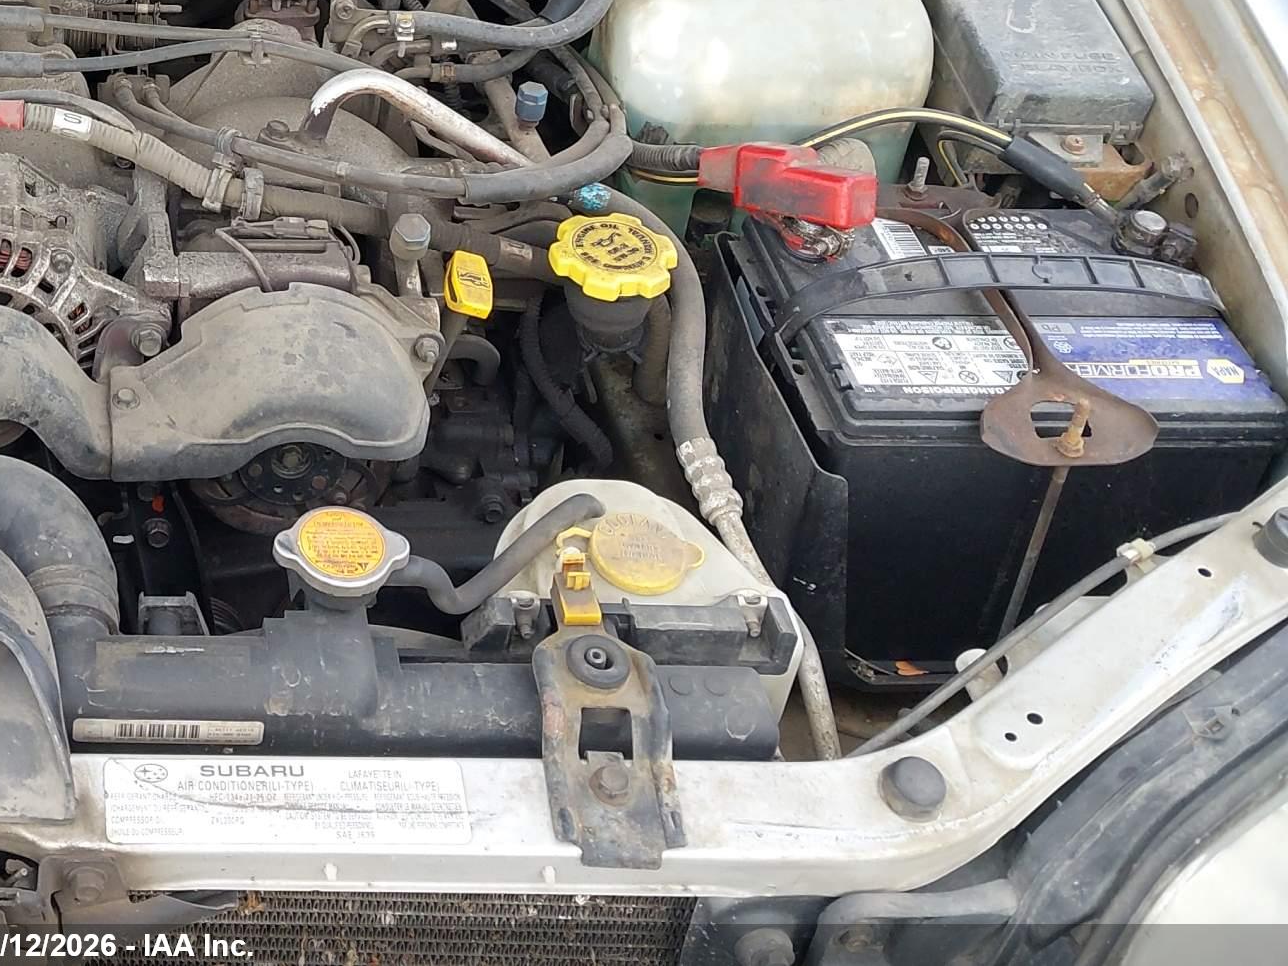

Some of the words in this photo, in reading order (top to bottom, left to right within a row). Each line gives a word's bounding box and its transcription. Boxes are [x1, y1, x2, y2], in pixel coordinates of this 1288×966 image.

[600, 222, 619, 230] OIL
[1040, 324, 1061, 332] Pb
[1212, 366, 1240, 378] NAPA
[902, 386, 1005, 394] DANGER/POISON
[199, 764, 305, 778] SUBARU
[177, 781, 196, 791] AIR
